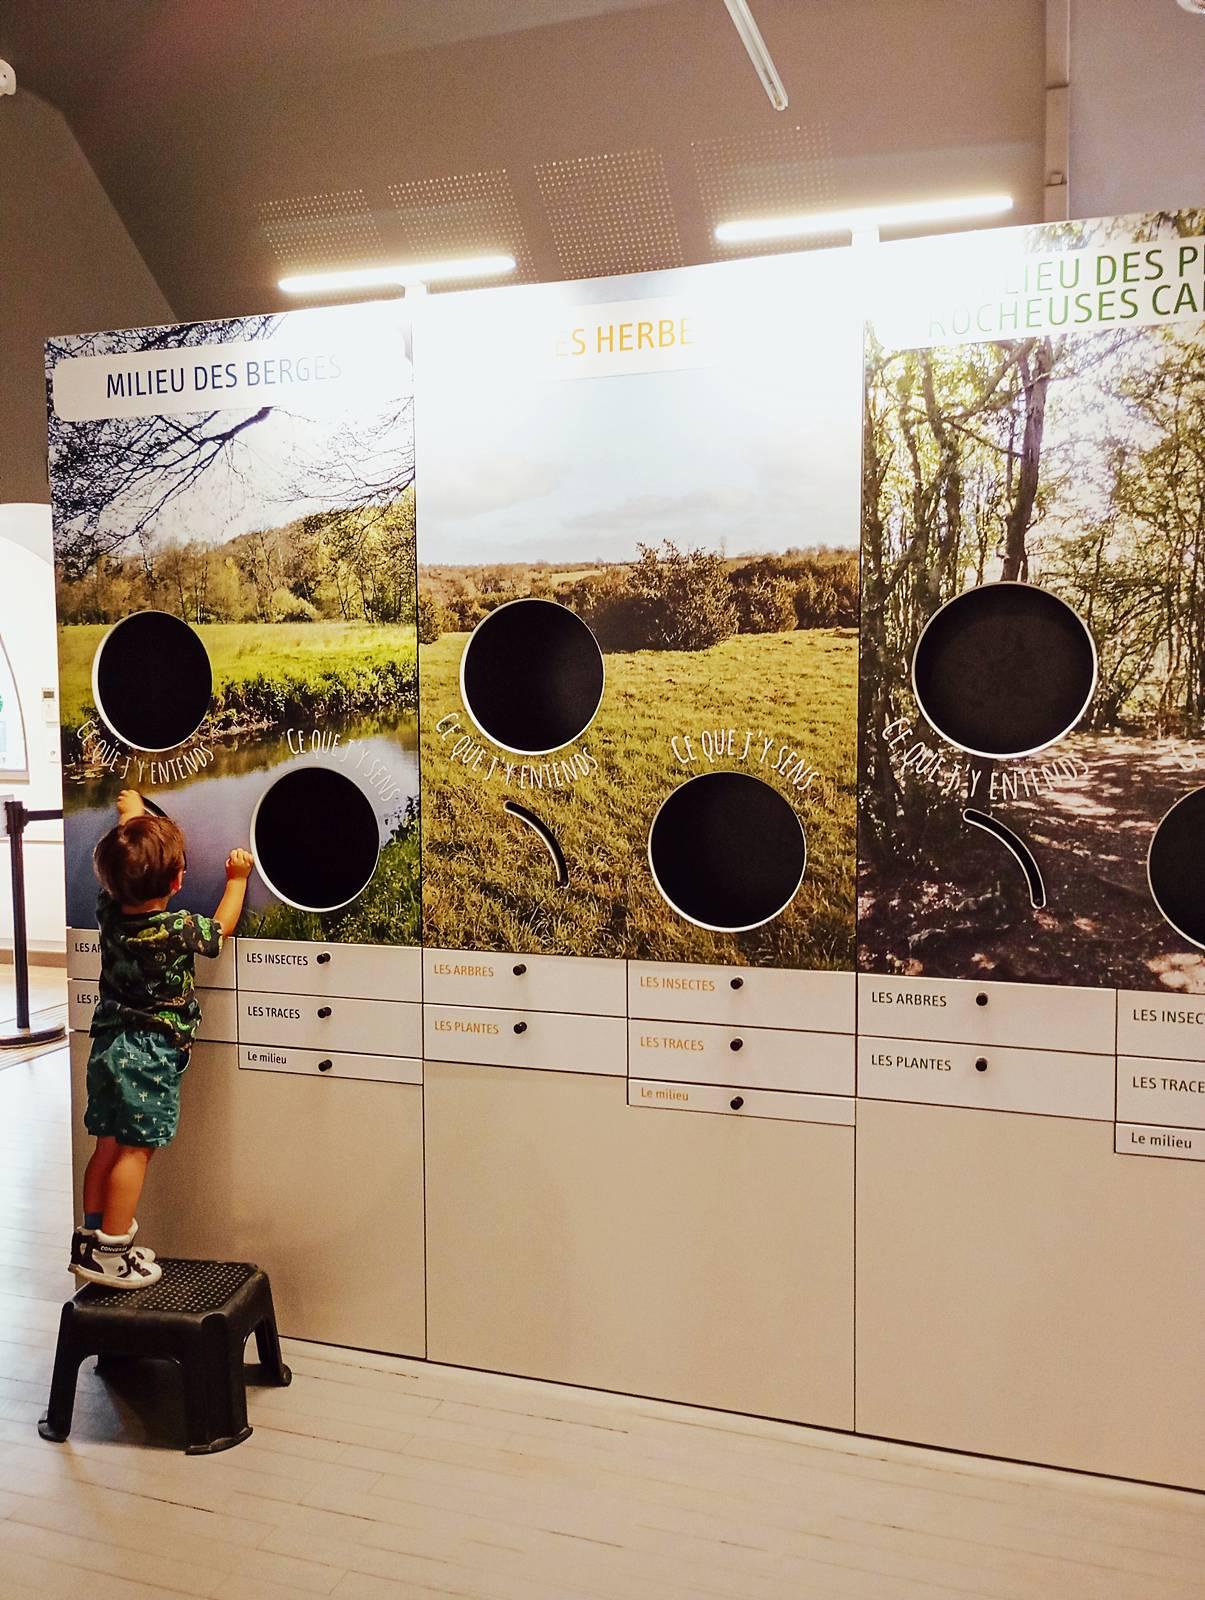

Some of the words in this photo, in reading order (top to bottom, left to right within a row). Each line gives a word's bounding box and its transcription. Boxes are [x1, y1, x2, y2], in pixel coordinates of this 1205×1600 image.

[1096, 249, 1164, 286] DES
[1178, 244, 1205, 277] P
[1151, 280, 1205, 316] CA
[597, 317, 695, 354] HERBE
[106, 367, 185, 399] MILIEU
[194, 363, 237, 391] DES
[246, 354, 342, 387] BERGES
[435, 712, 461, 741] CE
[450, 735, 487, 772] QUE
[483, 755, 515, 786] J'Y
[520, 746, 599, 790] ENTENDS
[881, 716, 914, 751] CE
[902, 741, 946, 784] QUE
[989, 754, 1089, 801] ENTENDS
[92, 739, 121, 773] QUE
[150, 741, 214, 785] ENTENDS
[286, 727, 306, 755] CE
[311, 729, 341, 760] QUE
[364, 759, 401, 802] SENS
[671, 735, 697, 764] CE
[701, 728, 736, 763] QUE
[738, 729, 774, 764] J'Y
[770, 745, 820, 791] SENS
[74, 942, 90, 953] LES
[246, 952, 263, 964] LES
[264, 953, 309, 966] INSECTES
[433, 963, 451, 975] LES
[453, 964, 495, 977] ARBRES
[640, 976, 660, 988] LES
[662, 977, 716, 992] INSECTES
[76, 993, 92, 1004] LES
[871, 991, 893, 1004] LES
[896, 993, 947, 1007] ARBRES
[247, 1006, 264, 1017] LES
[265, 1007, 301, 1020] TRACES
[1132, 1008, 1157, 1022] LES
[1161, 1010, 1205, 1025] INSEC
[434, 1020, 452, 1032] LES
[454, 1021, 500, 1035] PLANTES
[640, 1036, 660, 1048] LES
[663, 1037, 705, 1052] TRACES
[247, 1051, 258, 1061] Le
[259, 1052, 287, 1065] milieu
[871, 1054, 893, 1067] LES
[896, 1056, 952, 1072] PLANTES
[1132, 1076, 1157, 1090] LES
[641, 1087, 653, 1098] Le
[655, 1089, 689, 1101] milieu
[1131, 1131, 1146, 1145] Le
[1150, 1134, 1192, 1149] milieu
